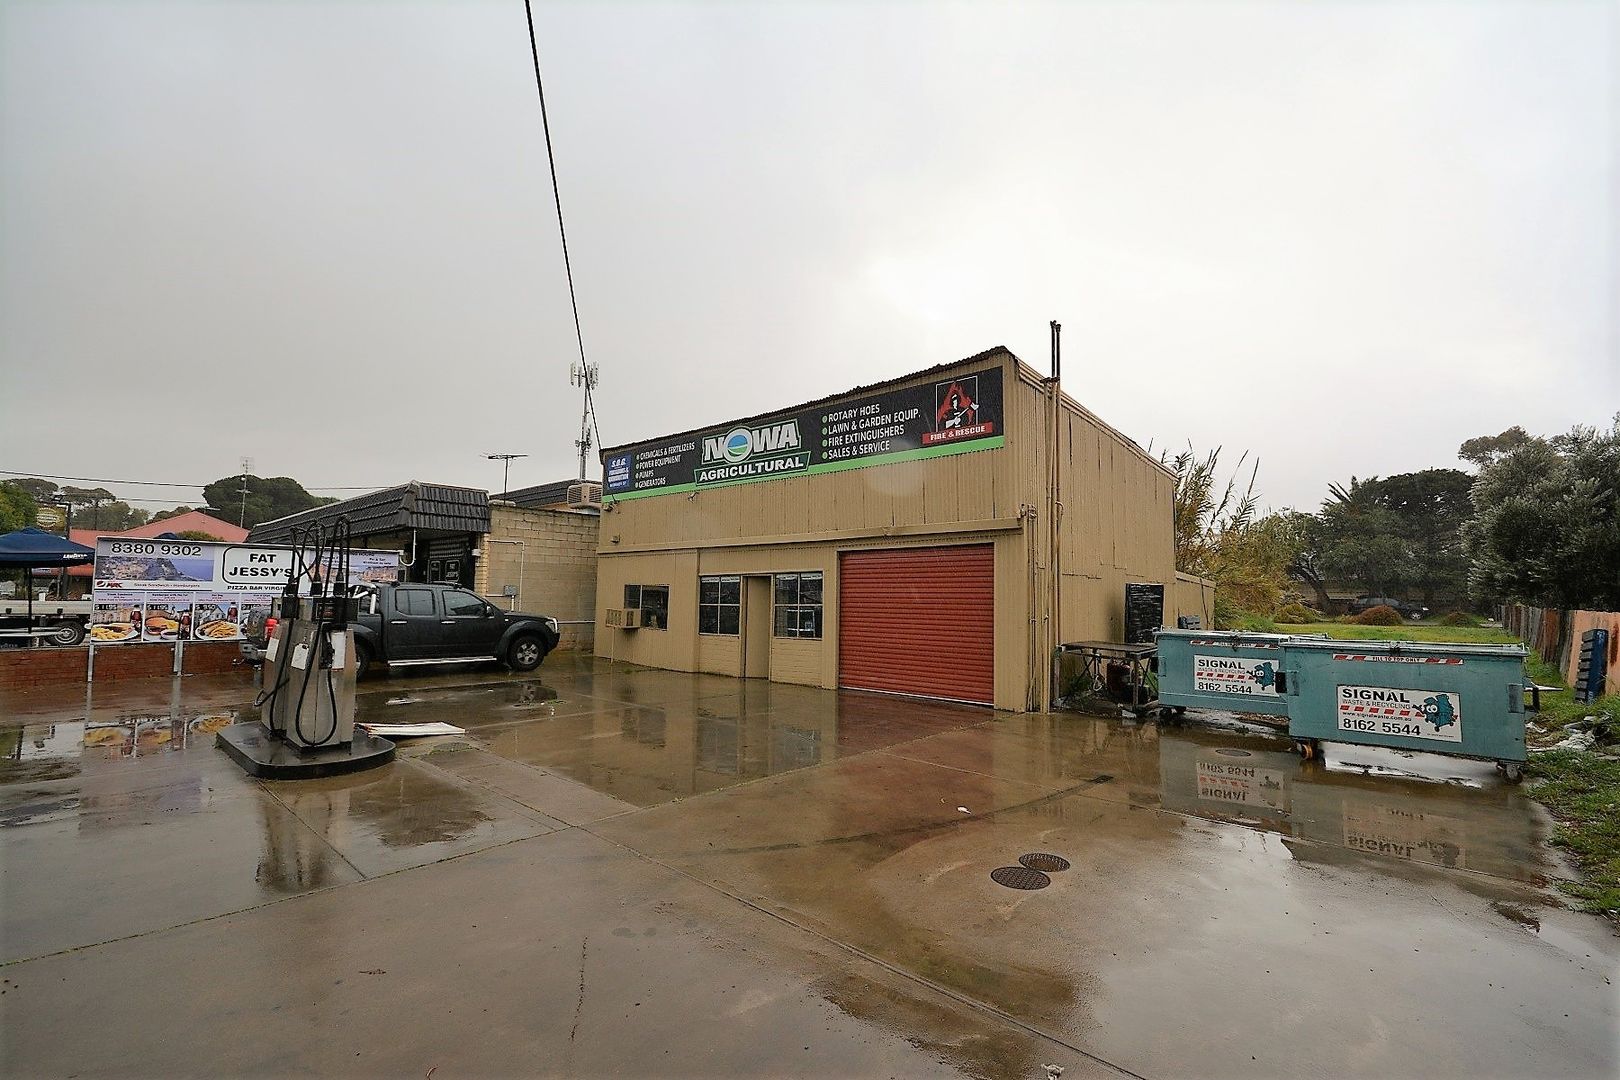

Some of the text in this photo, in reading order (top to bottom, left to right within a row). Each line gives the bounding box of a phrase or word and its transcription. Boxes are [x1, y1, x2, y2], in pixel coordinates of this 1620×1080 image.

[828, 403, 880, 422] ROTARY HOES
[828, 408, 921, 435] LAWN & GARDEN EQUIP.
[828, 424, 904, 447] FIRE EXTINGUISHERS
[930, 432, 946, 441] FIRE
[955, 425, 986, 436] RESCUE
[704, 422, 798, 463] NOWA
[828, 440, 890, 460] SALES & SERVICE
[640, 449, 663, 460] CHEMICALS
[668, 442, 695, 454] FERTILIZERS
[639, 455, 681, 470] POWER EQUIPMENT
[699, 457, 804, 481] AGRICULTURAL
[639, 470, 654, 479] PUMPS
[638, 477, 666, 488] GENERATORS
[111, 542, 201, 556] 8380 9302
[249, 553, 277, 563] FAT
[229, 567, 293, 578] JESSY'S
[1198, 659, 1245, 670] SIGNAL
[1198, 682, 1253, 694] 8162 5544
[1342, 688, 1410, 703] SIGNAL
[1372, 701, 1411, 709] RECYCLING
[1343, 718, 1376, 732] 8162
[1382, 722, 1421, 736] 5544
